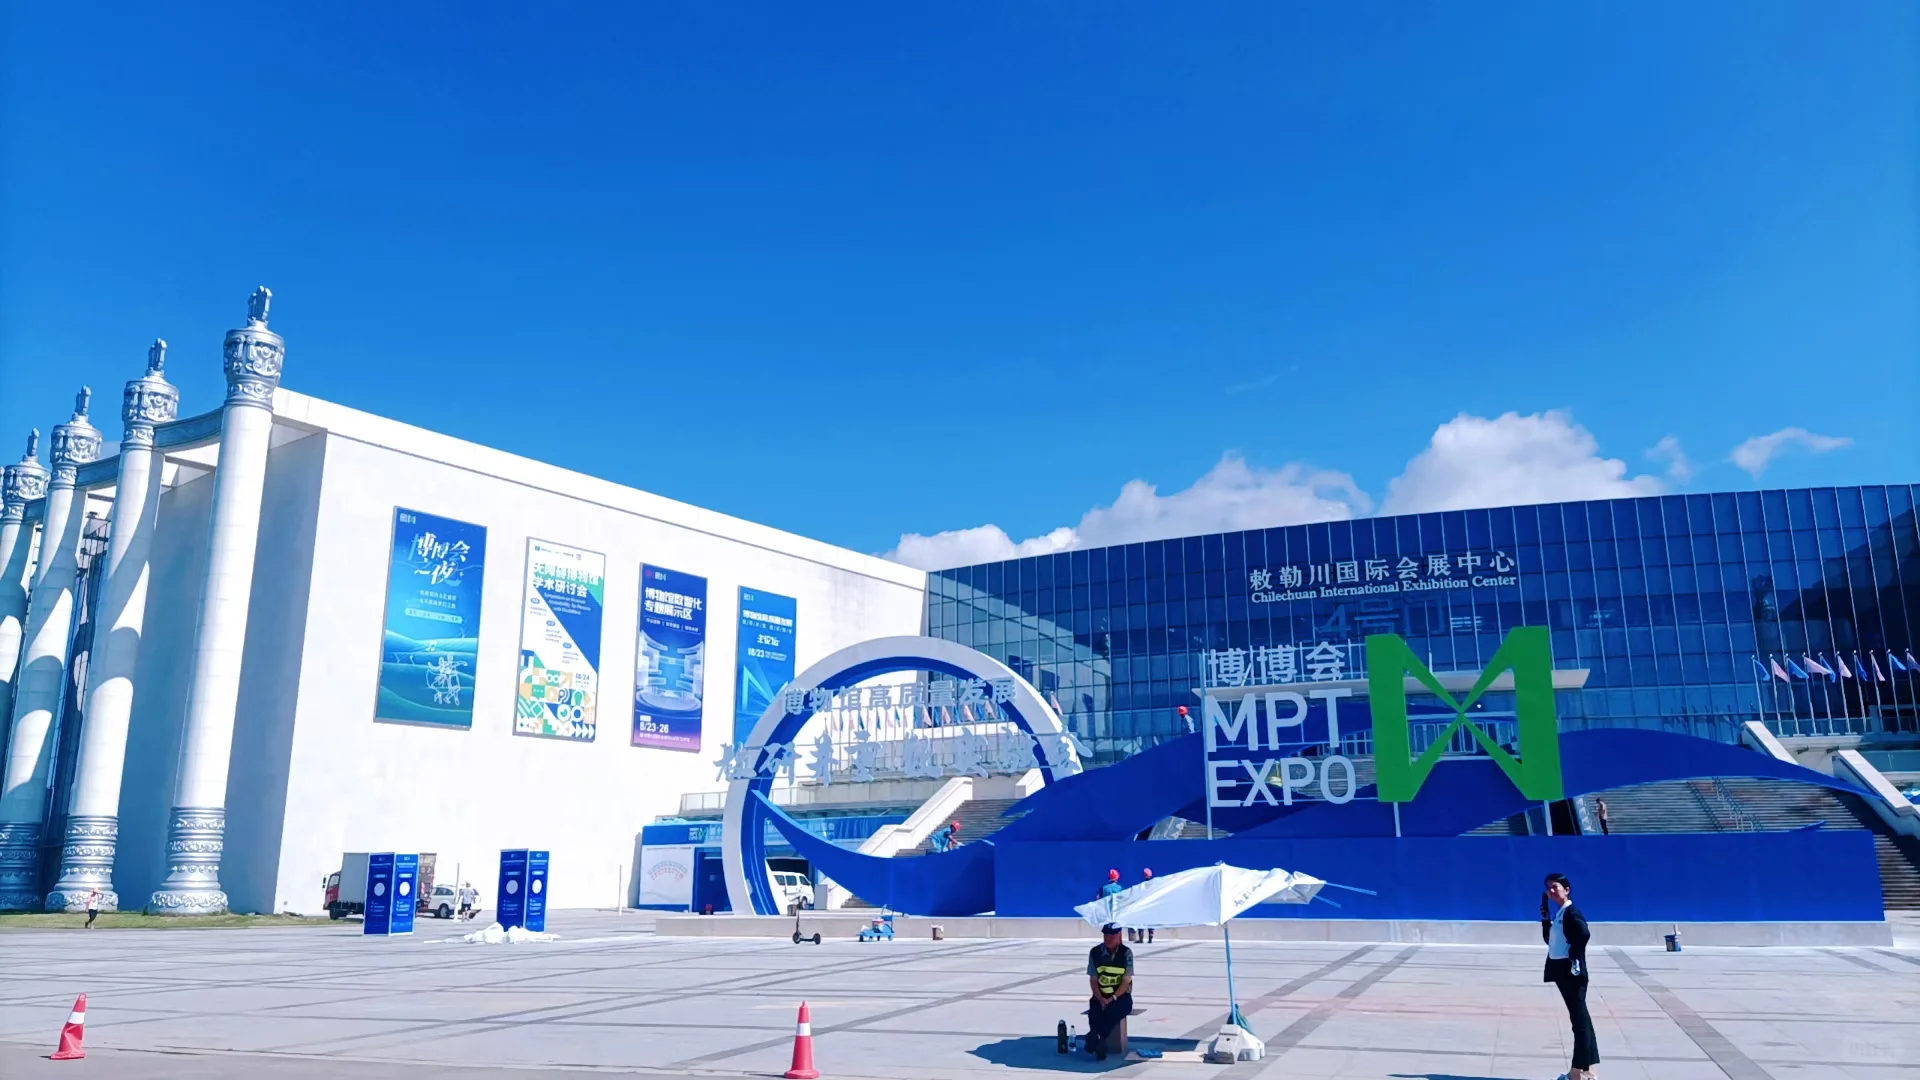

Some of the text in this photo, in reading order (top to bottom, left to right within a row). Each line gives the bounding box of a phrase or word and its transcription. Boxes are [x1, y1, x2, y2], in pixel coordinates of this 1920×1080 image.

[533, 576, 587, 597] 学术研讨会
[1250, 551, 1516, 591] 敕勒川国际会展中心
[1251, 575, 1517, 604] Chilechuan International Exhibition Center
[644, 600, 693, 620] 专题展示区
[645, 587, 702, 610] 博物馆数智化
[1207, 641, 1346, 687] 博博会
[783, 676, 1018, 716] 博物馆高质量发展
[1205, 688, 1352, 752] MPT
[1208, 755, 1357, 807] EXPO
